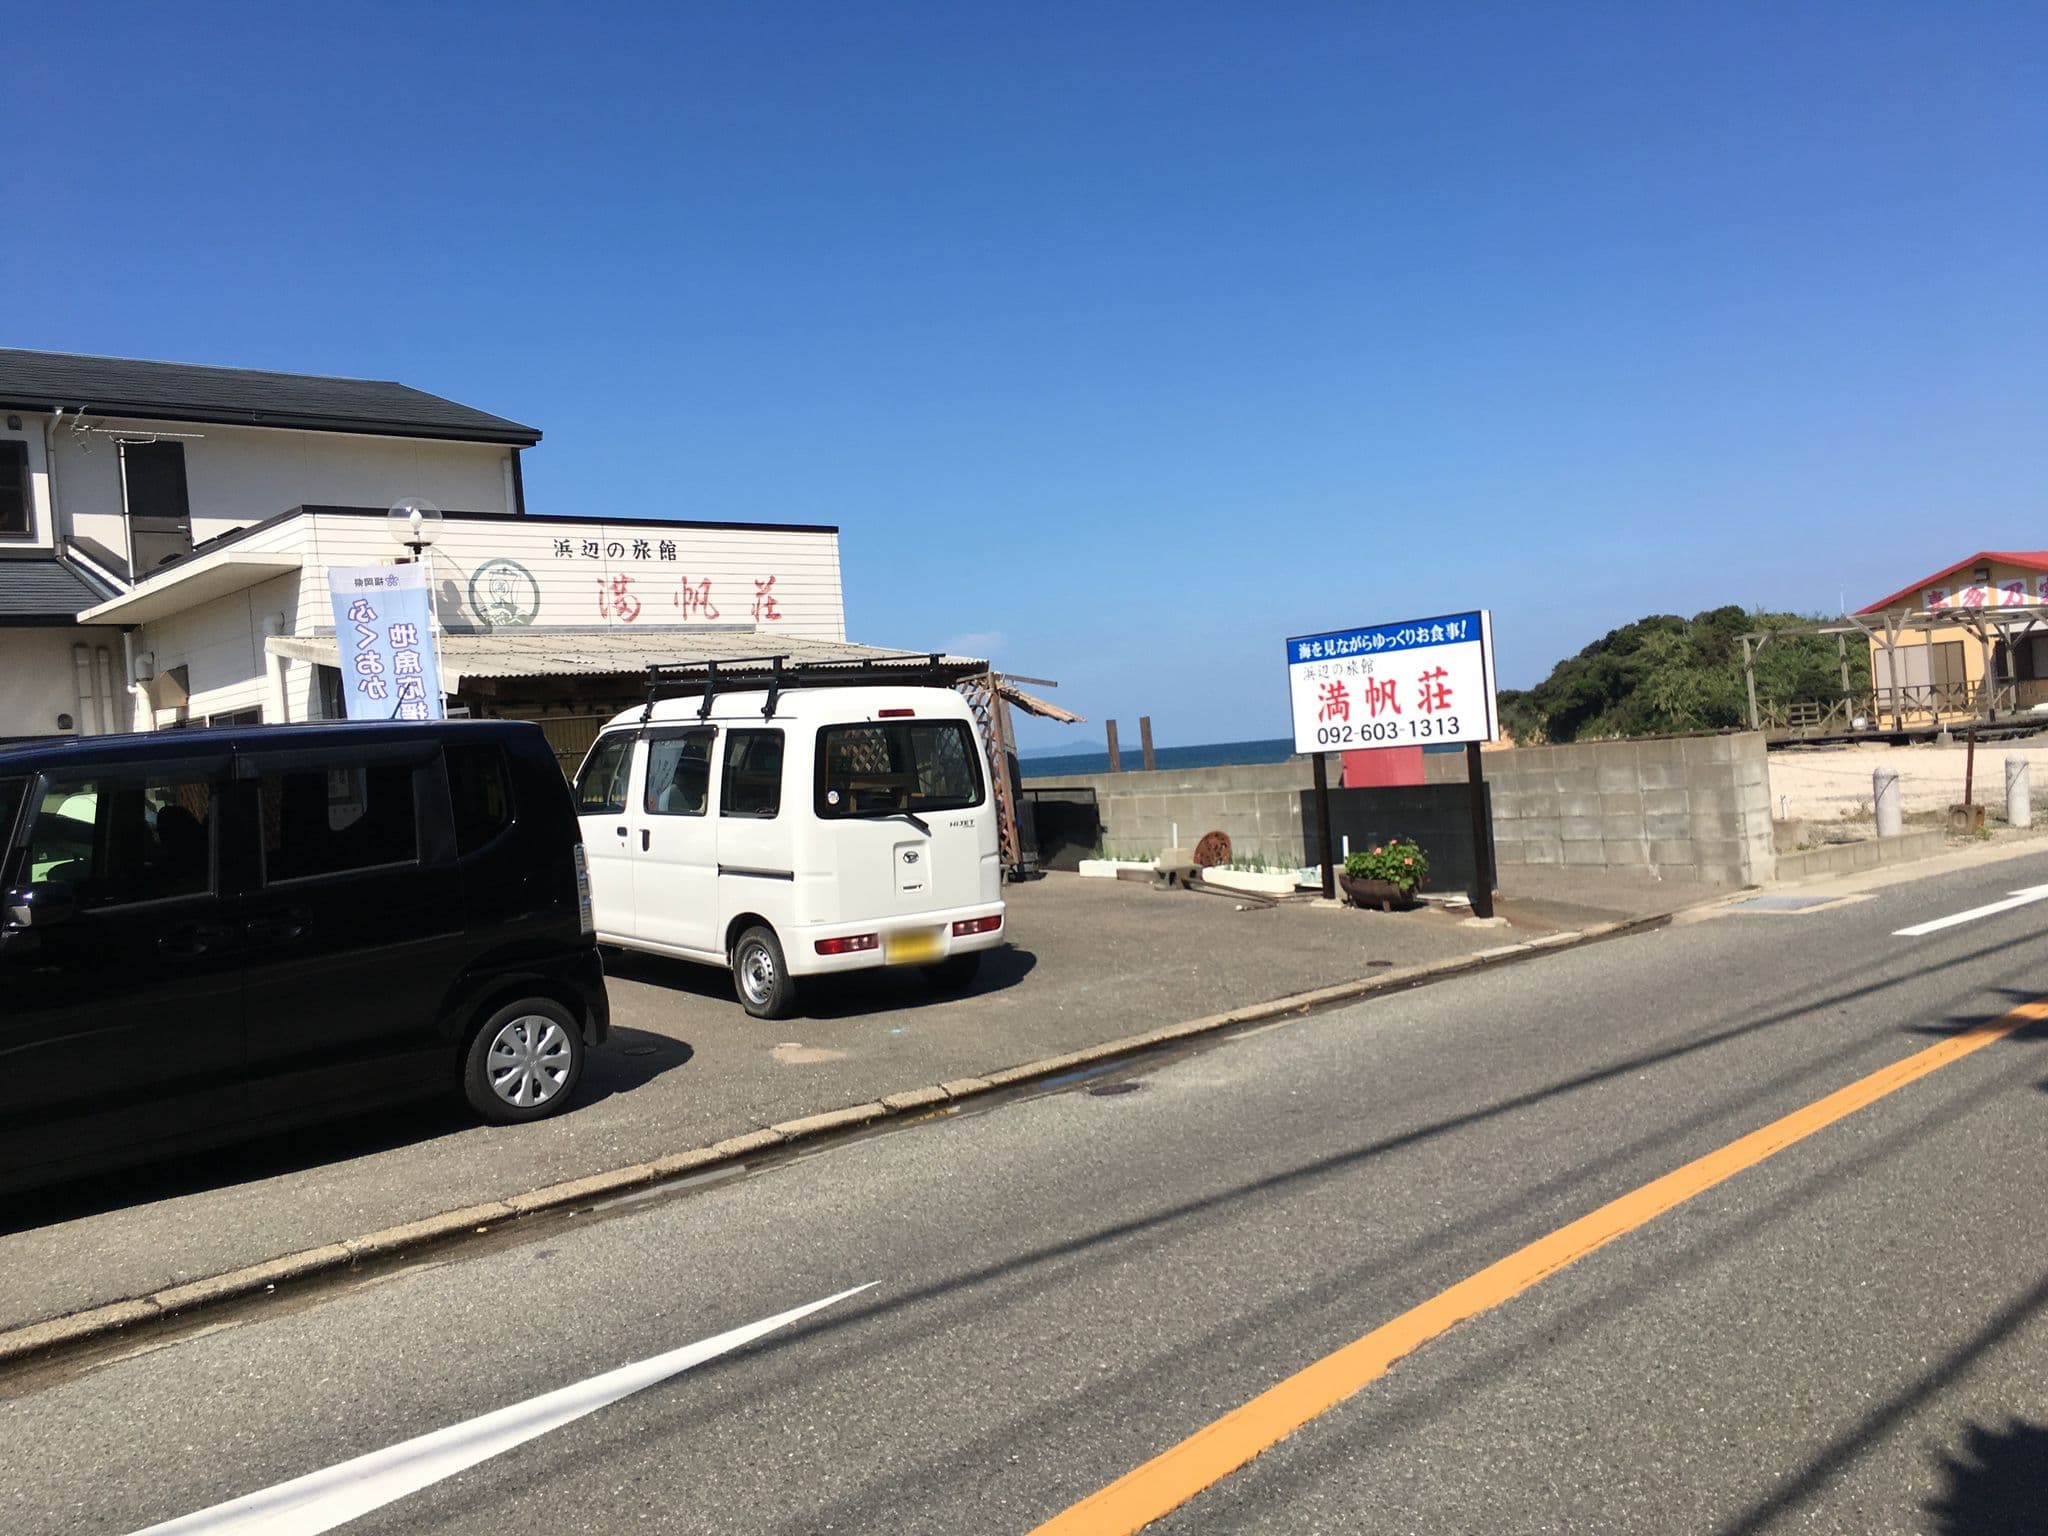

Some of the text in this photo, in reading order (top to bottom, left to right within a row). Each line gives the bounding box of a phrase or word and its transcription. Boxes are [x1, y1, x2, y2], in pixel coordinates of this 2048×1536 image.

[553, 538, 677, 561] 浜辺の旅館
[596, 572, 783, 623] 満帆荘
[1298, 619, 1467, 660] 海を見ながらゆっくりお食事!
[1303, 658, 1375, 681] 浜辺の旅館
[1317, 665, 1453, 723] 満帆荘
[1316, 716, 1461, 745] 092-603-1313
